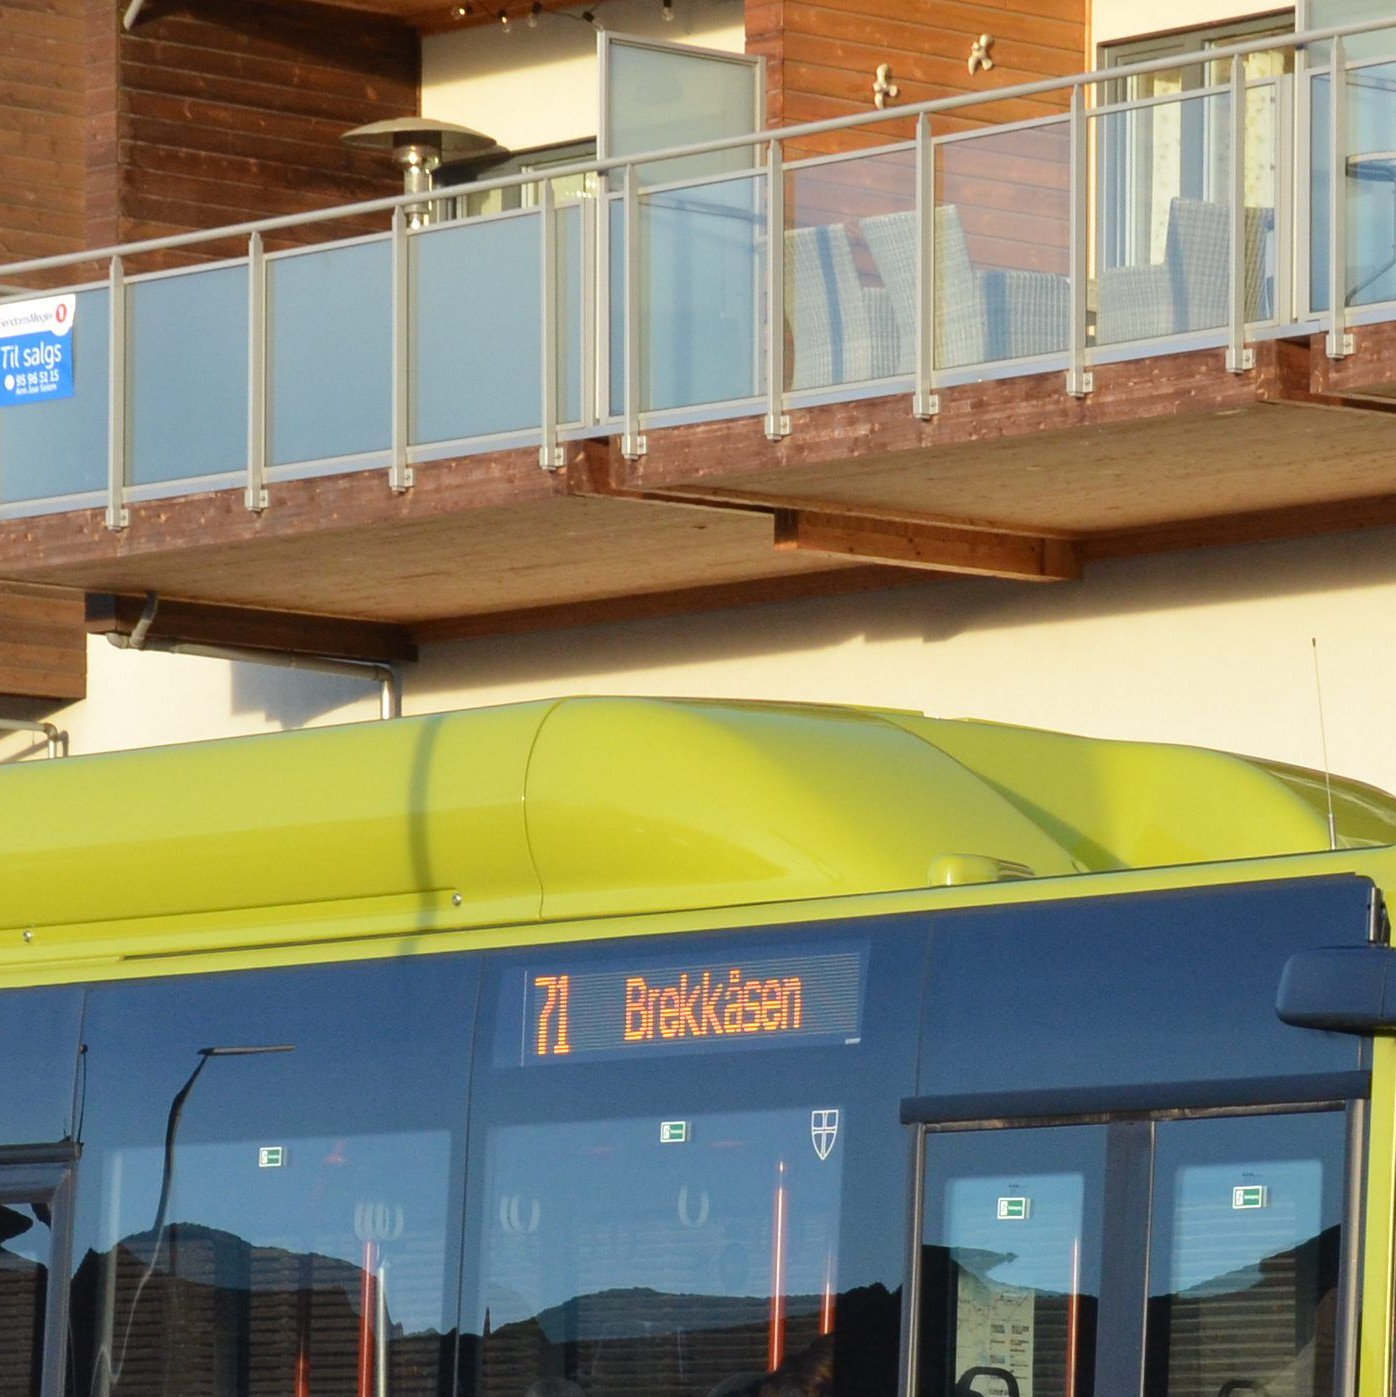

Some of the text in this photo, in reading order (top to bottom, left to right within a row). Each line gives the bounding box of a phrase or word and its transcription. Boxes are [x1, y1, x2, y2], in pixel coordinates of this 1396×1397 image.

[0, 341, 62, 370] Til salgs
[534, 969, 802, 1055] 71 Brekkåsen
